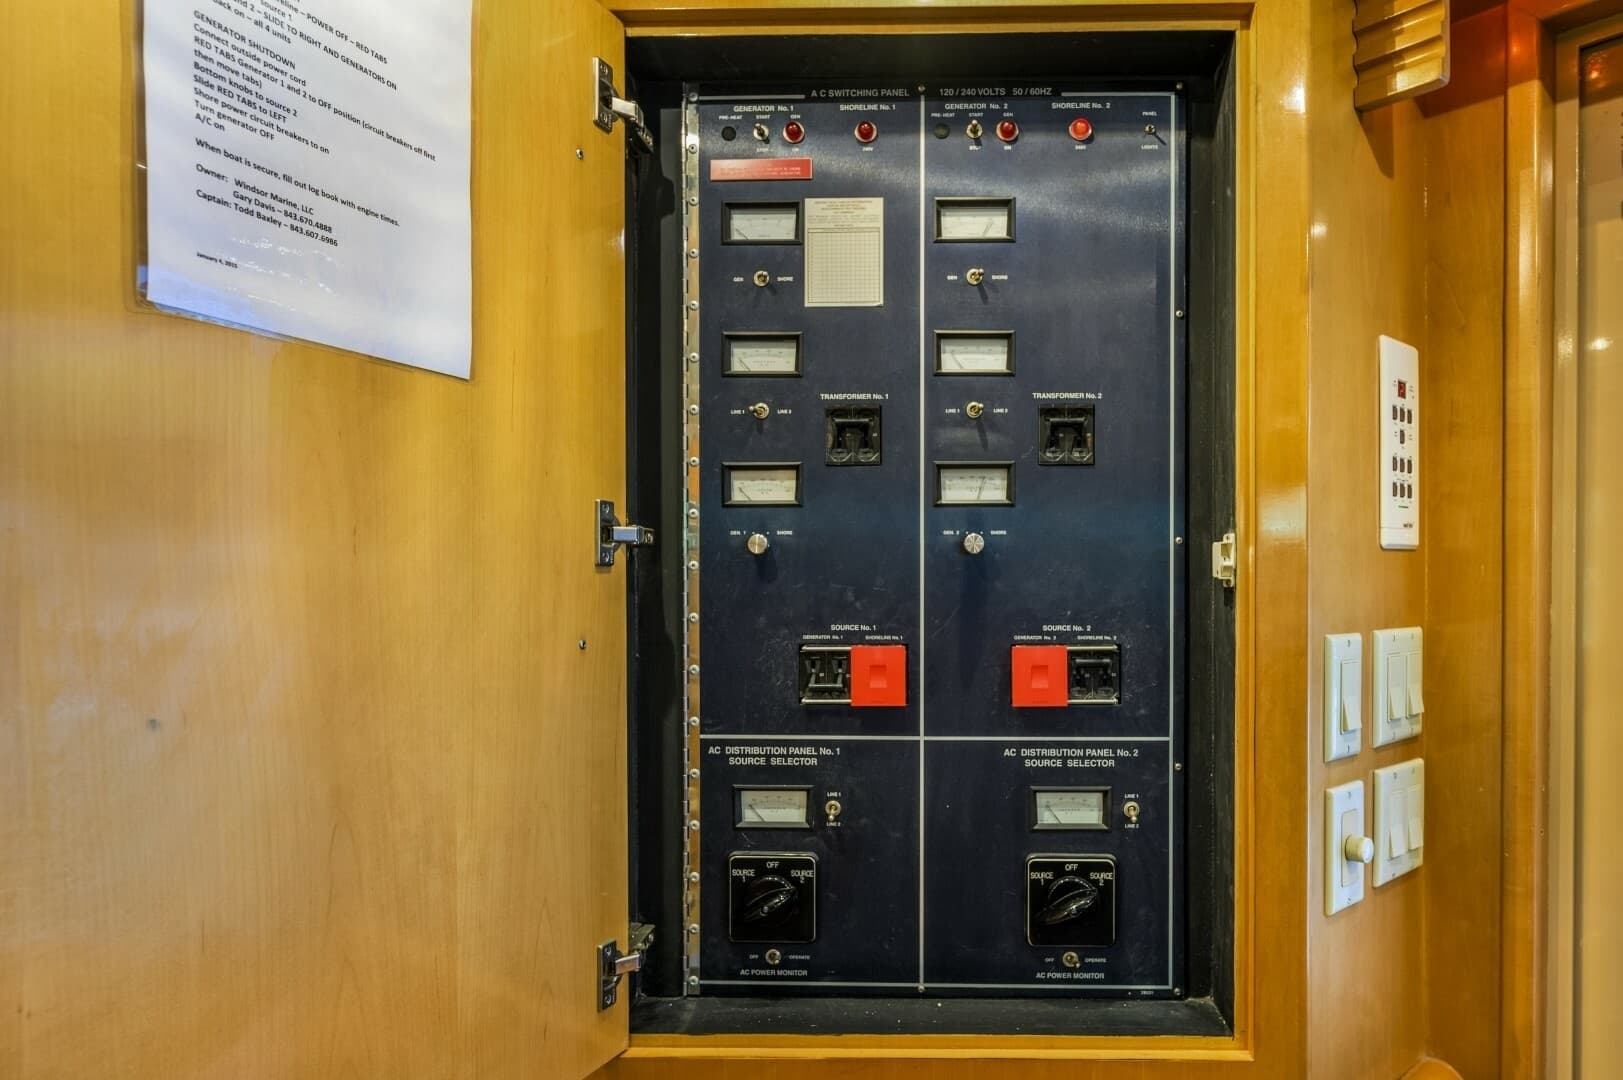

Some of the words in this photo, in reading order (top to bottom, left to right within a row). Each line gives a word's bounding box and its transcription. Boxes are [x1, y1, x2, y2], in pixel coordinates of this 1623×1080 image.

[194, 10, 246, 43] GENERATOR
[248, 40, 296, 69] SHUTDOWN
[234, 9, 244, 18] on
[254, 19, 264, 29] all
[272, 29, 291, 44] units
[264, 12, 284, 29] SLIDE
[288, 24, 297, 35] TO
[300, 31, 321, 48] RIGHT
[324, 46, 339, 58] AND
[340, 55, 385, 84] GENERATORS
[387, 80, 396, 90] ON
[306, 12, 334, 34] POWER
[335, 31, 348, 41] OFF
[356, 41, 369, 54] RED
[371, 50, 387, 64] TABS
[194, 23, 228, 47] Connect
[232, 44, 261, 63] outside
[264, 61, 287, 77] power
[290, 74, 306, 86] cord
[194, 49, 214, 64] then
[217, 61, 240, 77] move
[242, 73, 262, 88] tabs)
[194, 62, 226, 83] Bottom
[229, 78, 253, 96] knobs
[255, 92, 263, 100] to
[266, 97, 290, 113] source
[194, 36, 212, 50] RED
[215, 46, 235, 62] TABS
[238, 58, 278, 84] Generator
[287, 84, 300, 95] and
[309, 95, 316, 104] to
[318, 99, 332, 110] OFF
[333, 107, 360, 125] position
[362, 120, 384, 137] (circuit
[386, 132, 412, 150] breakers
[194, 74, 214, 90] Slide
[217, 85, 234, 99] RED
[236, 95, 257, 110] TABS
[259, 106, 267, 114] to
[270, 110, 286, 123] LEFT
[828, 89, 878, 97] SWITCHING
[881, 88, 910, 96] PANEL
[194, 87, 218, 104] Shore
[222, 102, 247, 117] power
[250, 113, 274, 129] circuit
[276, 125, 309, 146] breakers
[311, 141, 318, 149] to
[320, 146, 329, 154] on
[195, 100, 214, 114] Turn
[217, 112, 257, 134] generator
[260, 129, 274, 141] OFF
[196, 113, 211, 126] A/C
[214, 123, 225, 131] on
[196, 138, 221, 155] When
[224, 150, 242, 163] boat
[245, 158, 251, 167] is
[253, 163, 280, 180] secure,
[283, 174, 292, 184] fill
[294, 181, 306, 190] out
[309, 184, 319, 196] log
[322, 189, 338, 202] book
[340, 199, 356, 209] with
[357, 205, 379, 218] engine
[196, 163, 228, 182] Owner:
[234, 178, 268, 198] Windsor
[270, 192, 299, 211] Marine,
[302, 205, 314, 215] LLC
[196, 189, 232, 208] Captain:
[234, 203, 254, 216] Todd
[256, 211, 281, 228] Baxley
[290, 224, 338, 246] 843.607.6986
[233, 191, 252, 205] Gary
[254, 199, 275, 212] Davis
[284, 210, 332, 234] 843.670.4888
[725, 747, 787, 755] DISTRIBUTION
[788, 747, 818, 755] PANEL
[819, 747, 835, 755] No.
[729, 757, 766, 765] SOURCE
[770, 757, 818, 766] SELECTOR
[1021, 749, 1084, 757] DISTRIBUTION
[1025, 759, 1062, 767] SOURCE
[1067, 759, 1115, 767] SELECTOR
